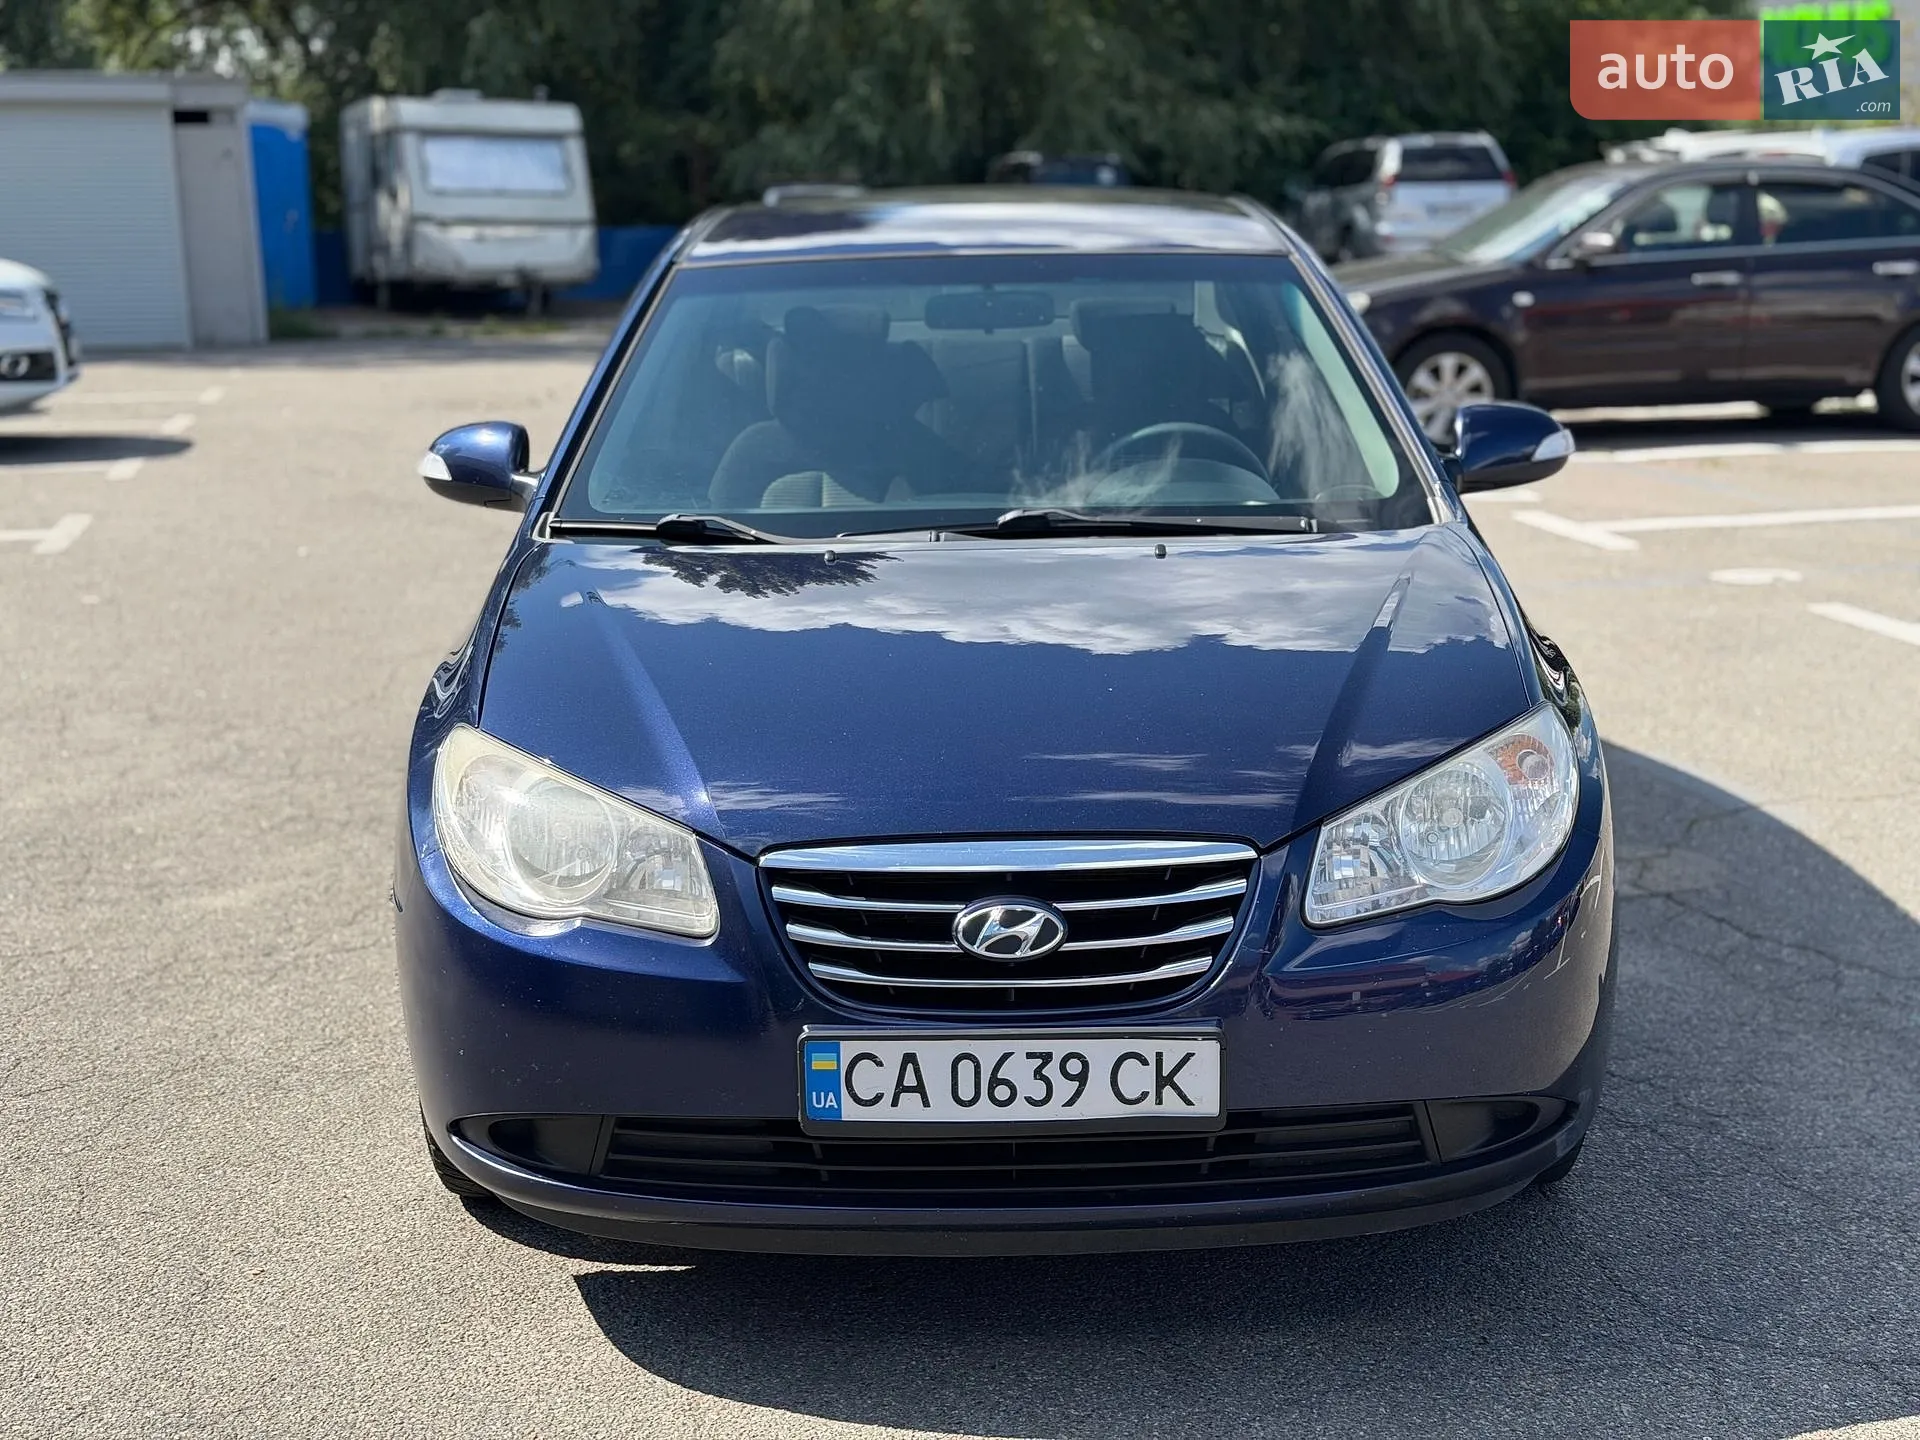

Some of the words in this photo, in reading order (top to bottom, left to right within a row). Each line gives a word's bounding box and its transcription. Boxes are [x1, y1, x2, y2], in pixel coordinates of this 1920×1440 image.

[844, 1051, 932, 1108] CA
[950, 1051, 1090, 1108] 0639
[1109, 1051, 1196, 1107] CK
[812, 1091, 838, 1109] UA
